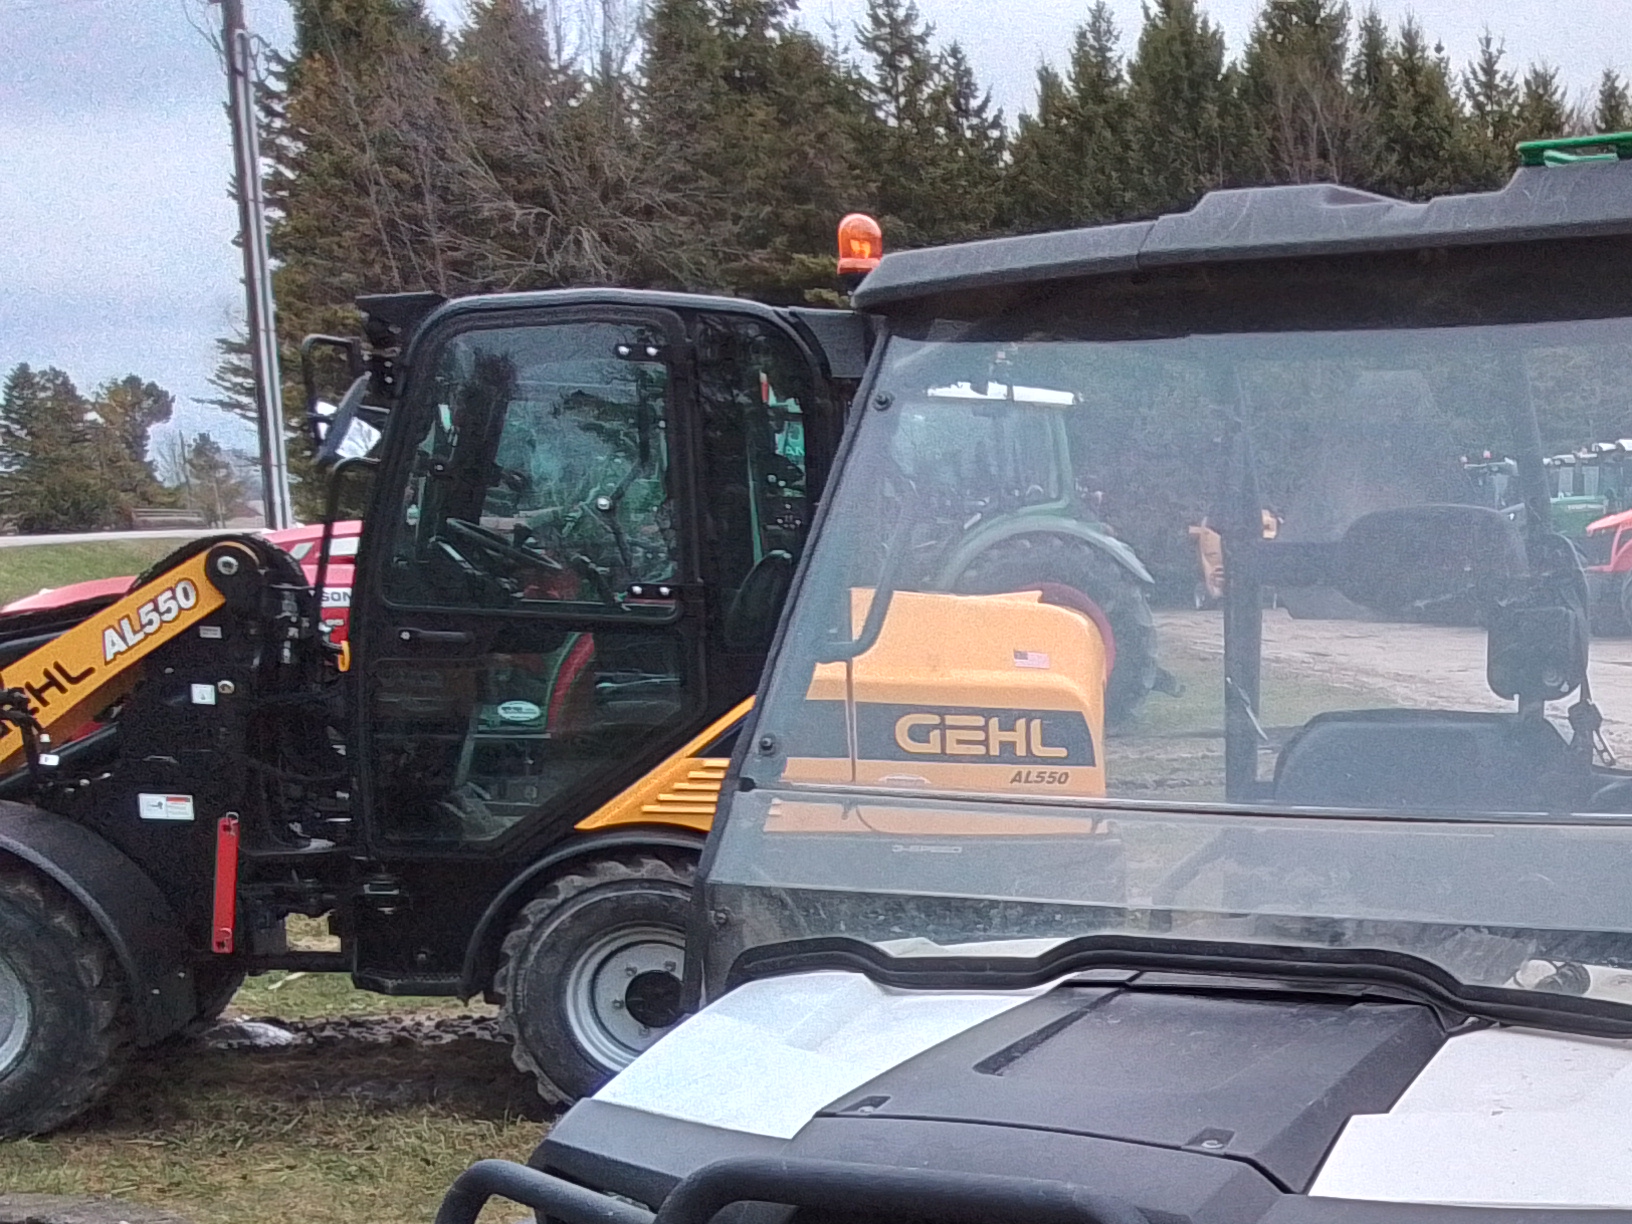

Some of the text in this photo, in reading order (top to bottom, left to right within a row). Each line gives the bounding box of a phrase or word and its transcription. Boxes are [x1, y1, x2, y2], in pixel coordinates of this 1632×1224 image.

[101, 577, 198, 666] AL550
[894, 712, 1069, 759] GEHL
[1010, 770, 1069, 785] AL550
